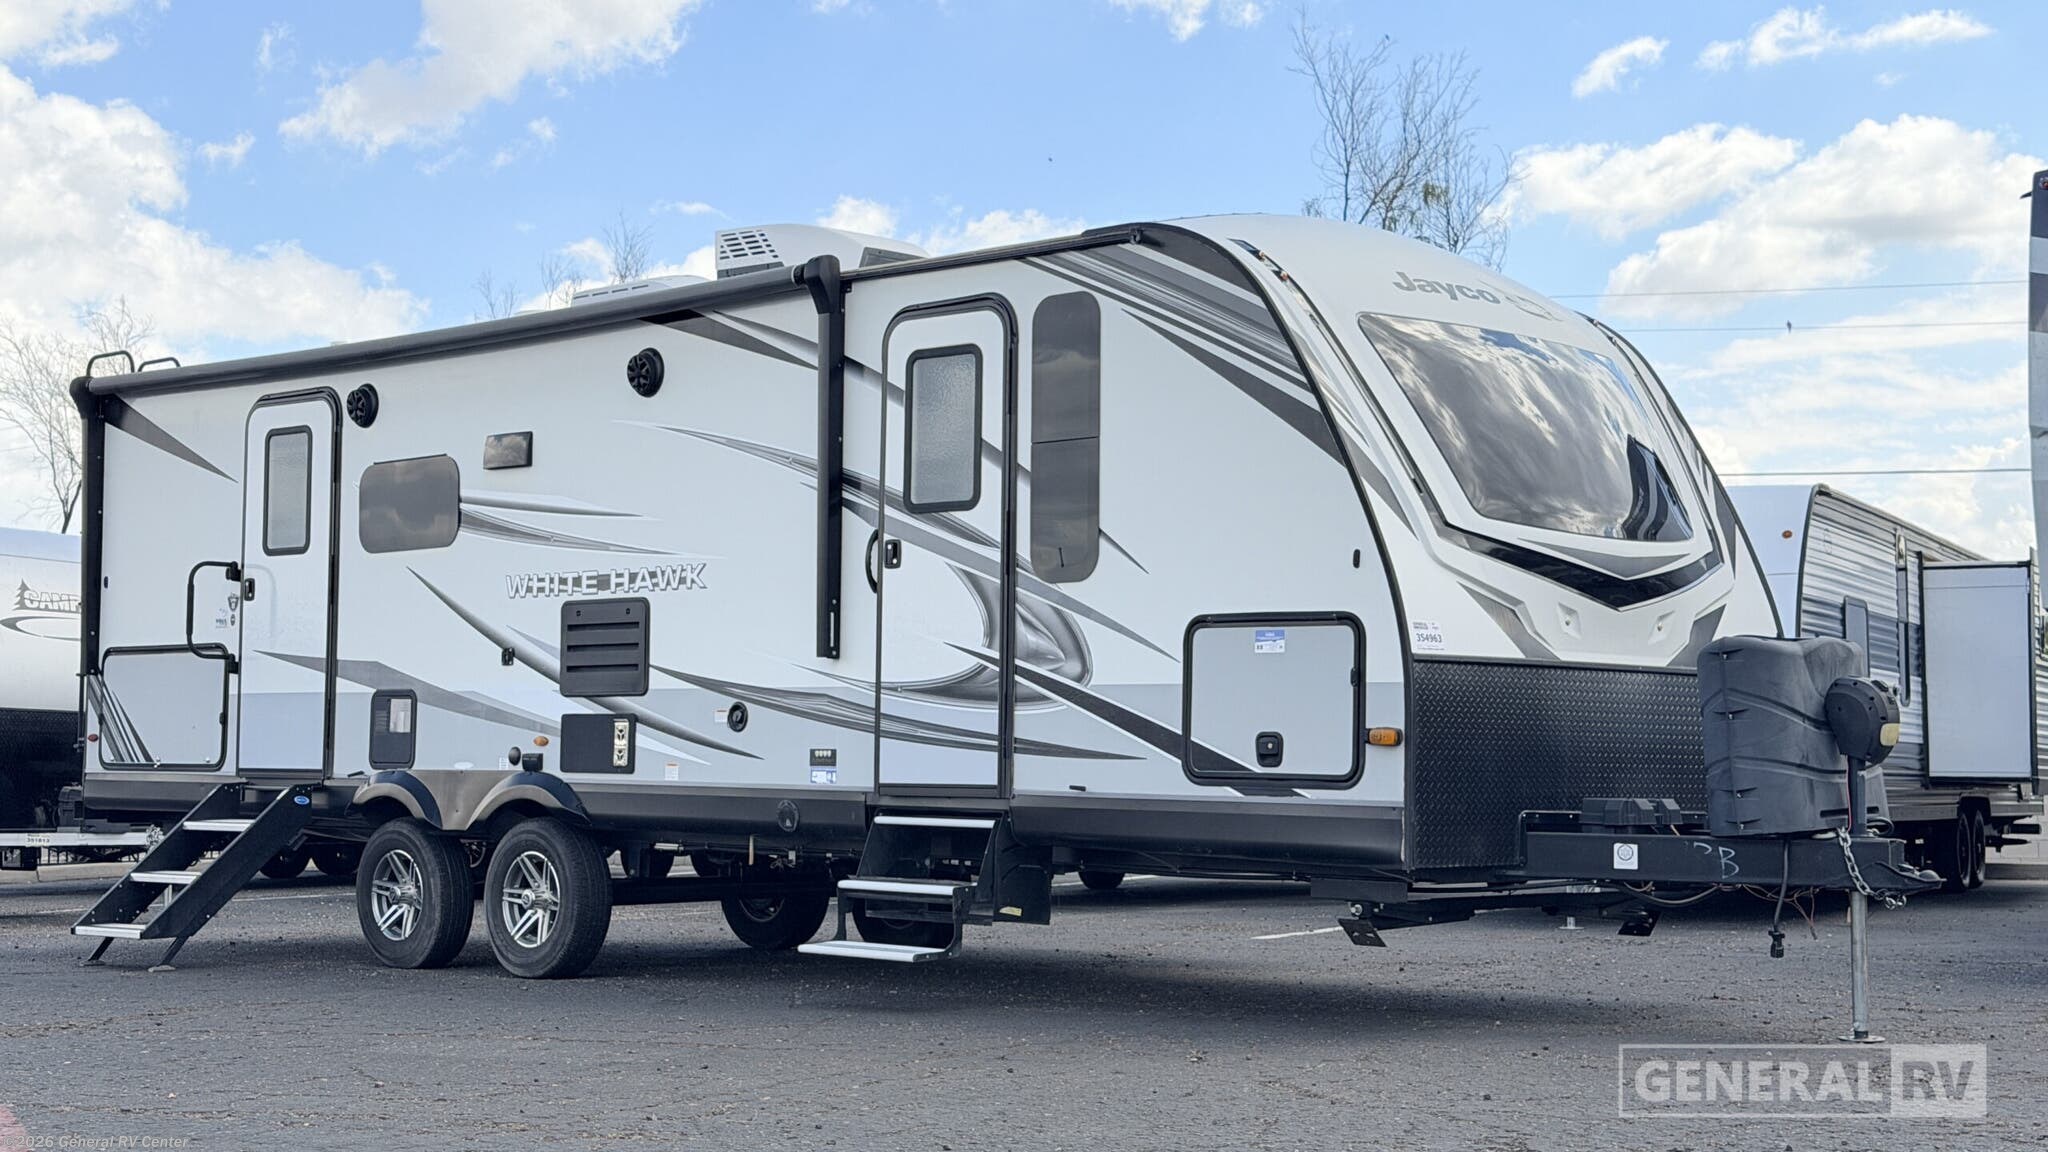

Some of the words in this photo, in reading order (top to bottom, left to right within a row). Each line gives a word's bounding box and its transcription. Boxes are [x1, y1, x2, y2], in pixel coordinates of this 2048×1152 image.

[1392, 271, 1501, 305] Jayco
[505, 569, 600, 599] WHITE
[609, 563, 708, 594] HAWK
[1415, 632, 1443, 643] 354963
